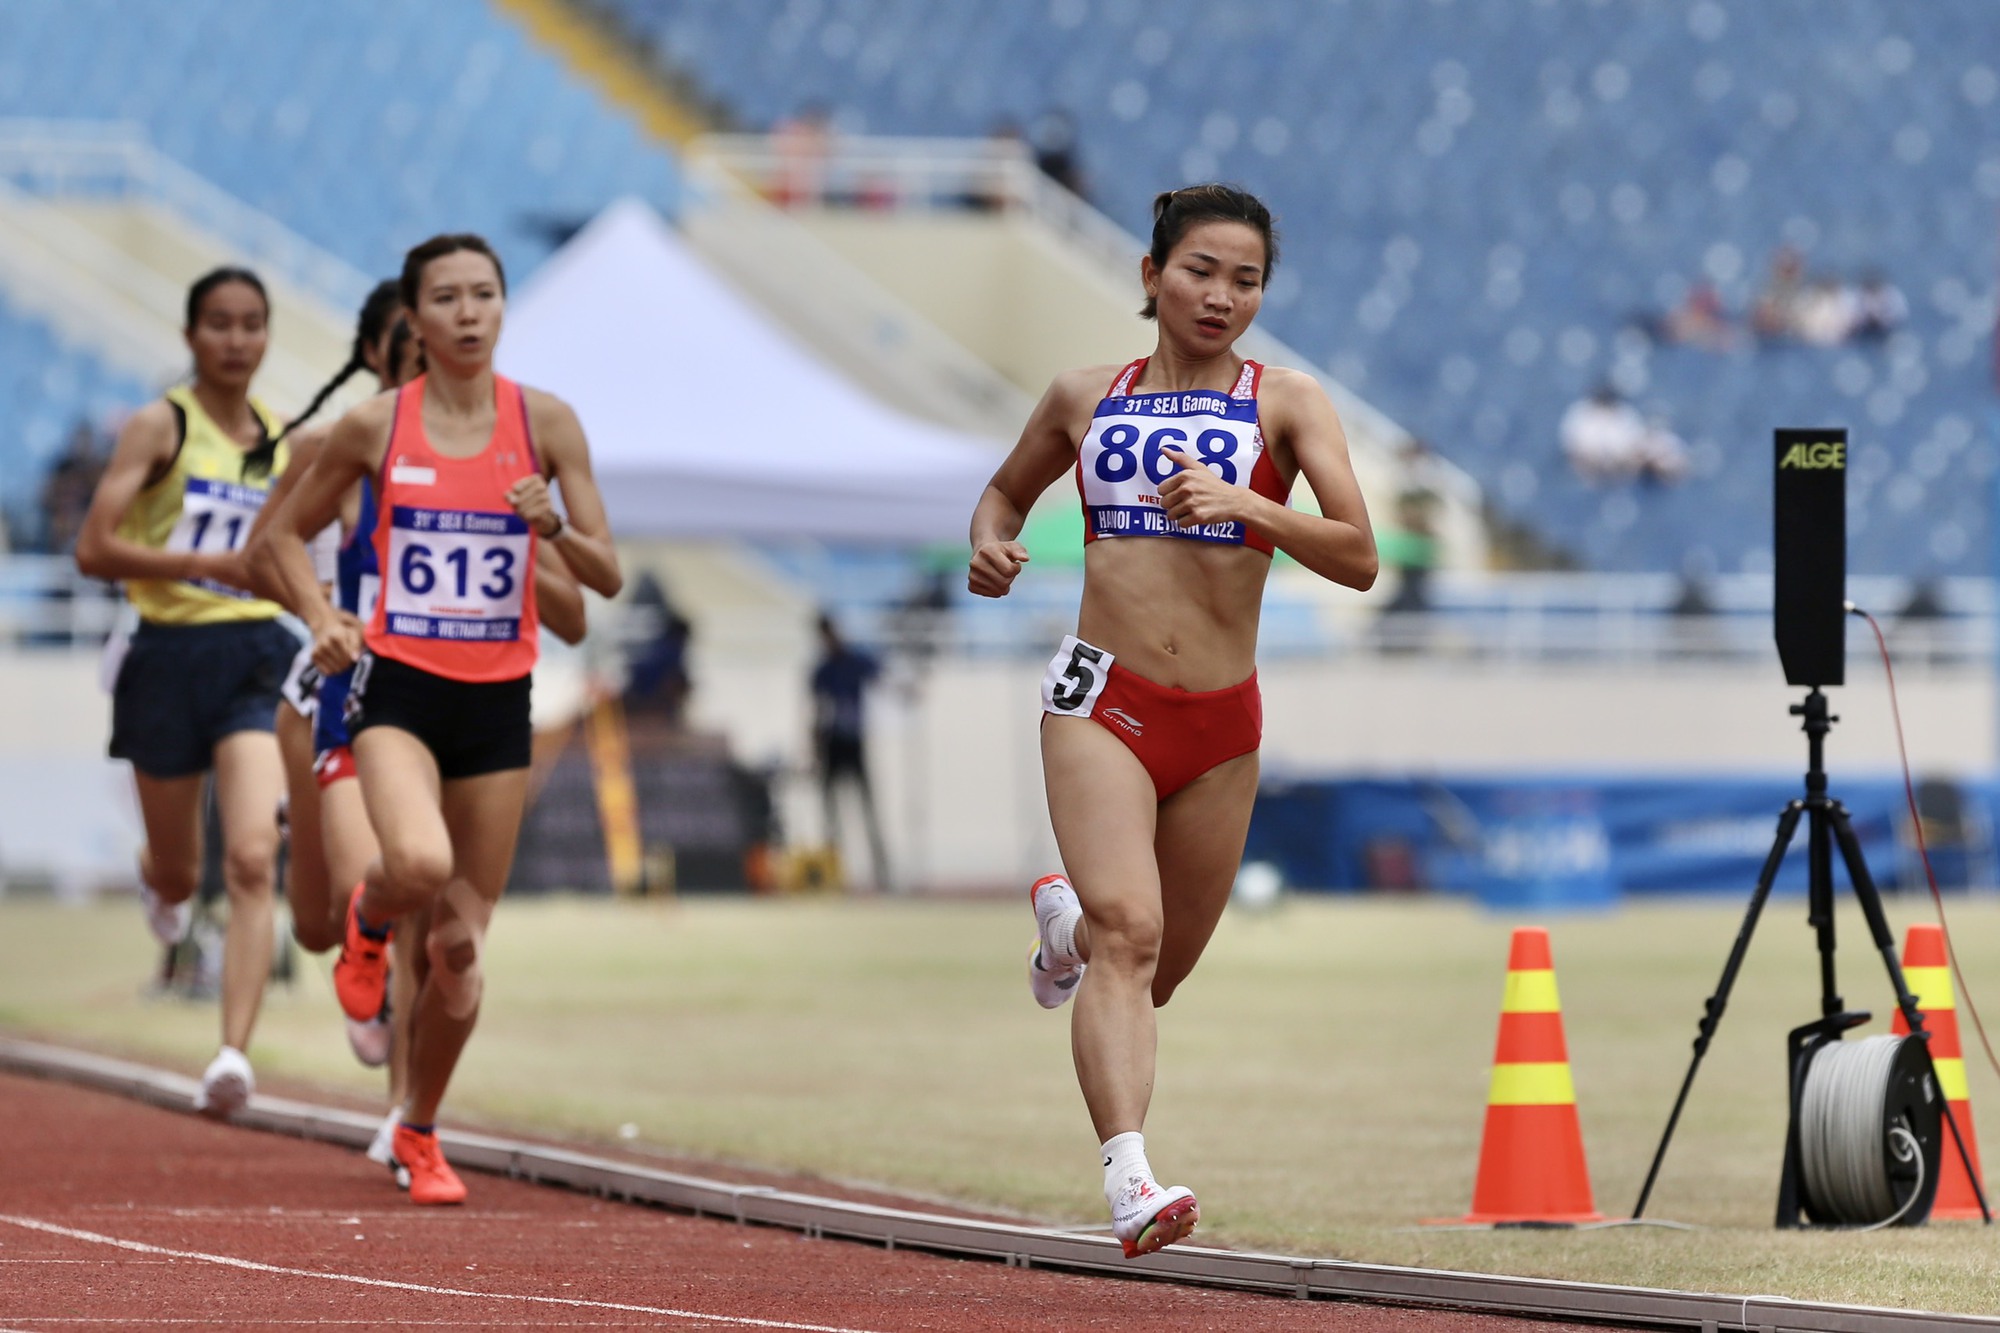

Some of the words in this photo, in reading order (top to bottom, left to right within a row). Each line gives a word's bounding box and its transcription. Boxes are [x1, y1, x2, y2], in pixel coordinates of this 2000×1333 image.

[1152, 396, 1178, 414] SEA
[1182, 395, 1227, 415] Games
[1095, 424, 1238, 486] 868
[1780, 442, 1846, 469] ALGE
[1138, 494, 1161, 505] VIET
[1098, 510, 1131, 529] HANOI
[1203, 520, 1236, 538] 2022
[399, 543, 515, 599] 613
[1053, 643, 1104, 710] 5
